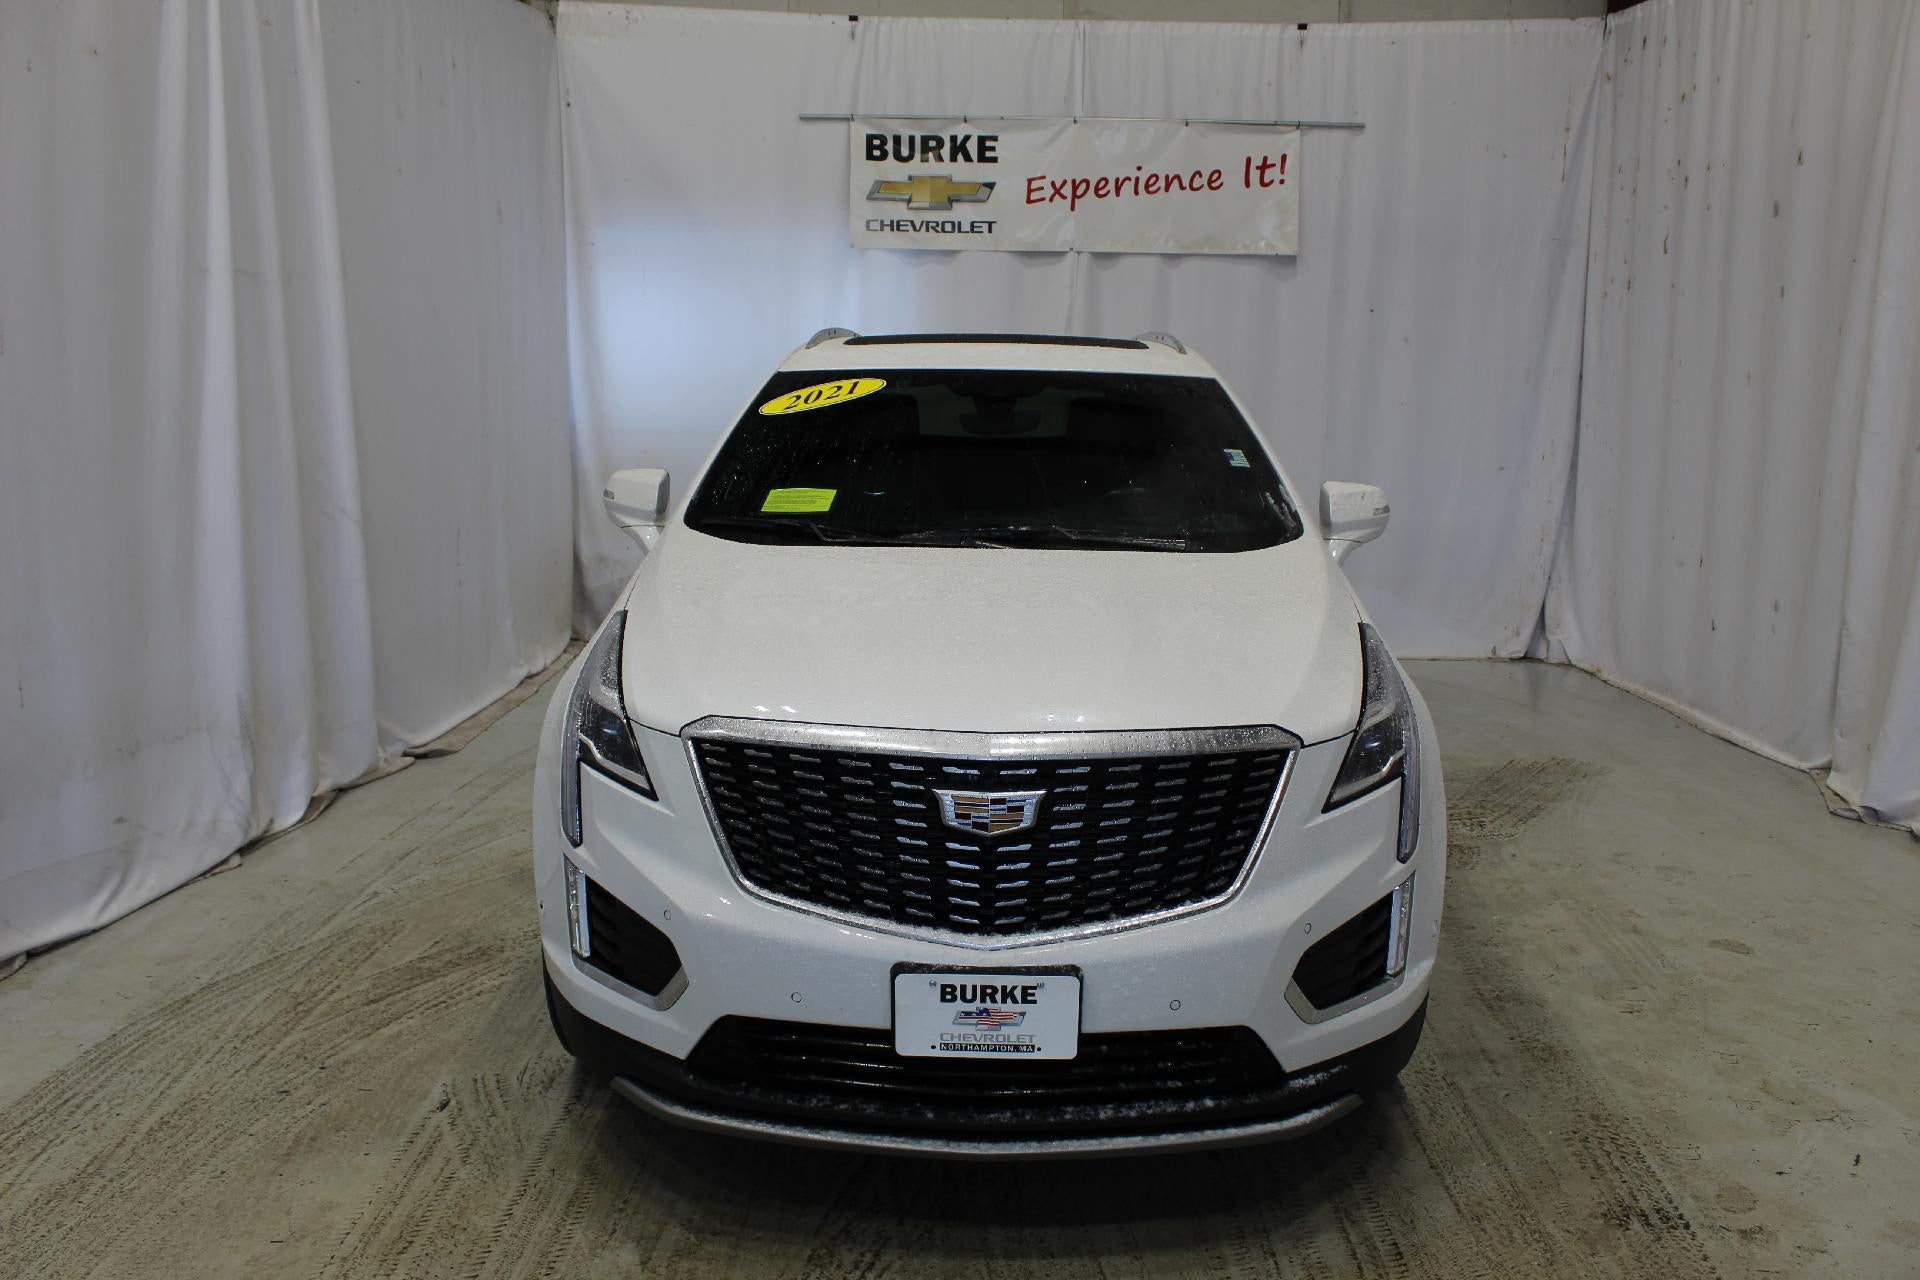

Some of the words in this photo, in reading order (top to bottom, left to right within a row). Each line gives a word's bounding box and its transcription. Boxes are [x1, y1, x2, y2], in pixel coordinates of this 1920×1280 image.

[865, 133, 999, 163] BURKE
[1025, 165, 1225, 212] Experience
[1243, 153, 1288, 189] It!
[865, 218, 997, 234] CHEVROLET
[783, 380, 860, 411] 2021
[939, 983, 1038, 1005] BURKE
[939, 1032, 1037, 1044] CHEVROLET
[1019, 1043, 1034, 1053] MA
